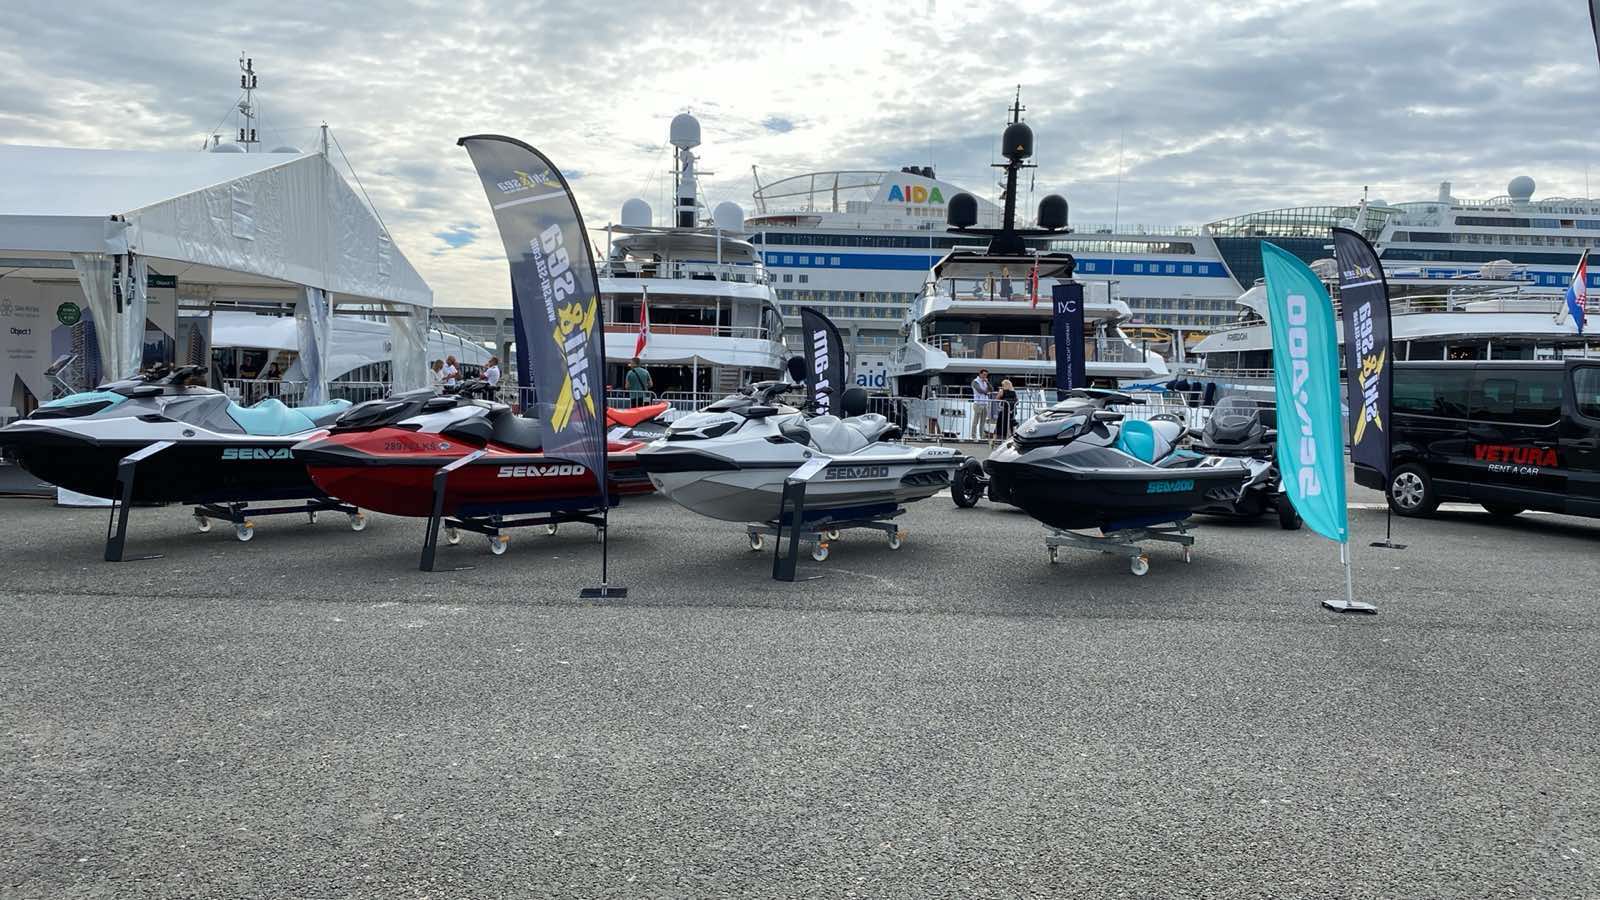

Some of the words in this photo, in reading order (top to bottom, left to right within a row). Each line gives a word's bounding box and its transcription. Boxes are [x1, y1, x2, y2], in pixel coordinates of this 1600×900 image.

[888, 184, 945, 204] AIDA
[1058, 300, 1077, 313] IYC
[10, 327, 27, 336] Object
[1473, 444, 1558, 466] VETURA
[1487, 464, 1512, 473] RENT
[1520, 466, 1540, 476] CAR
